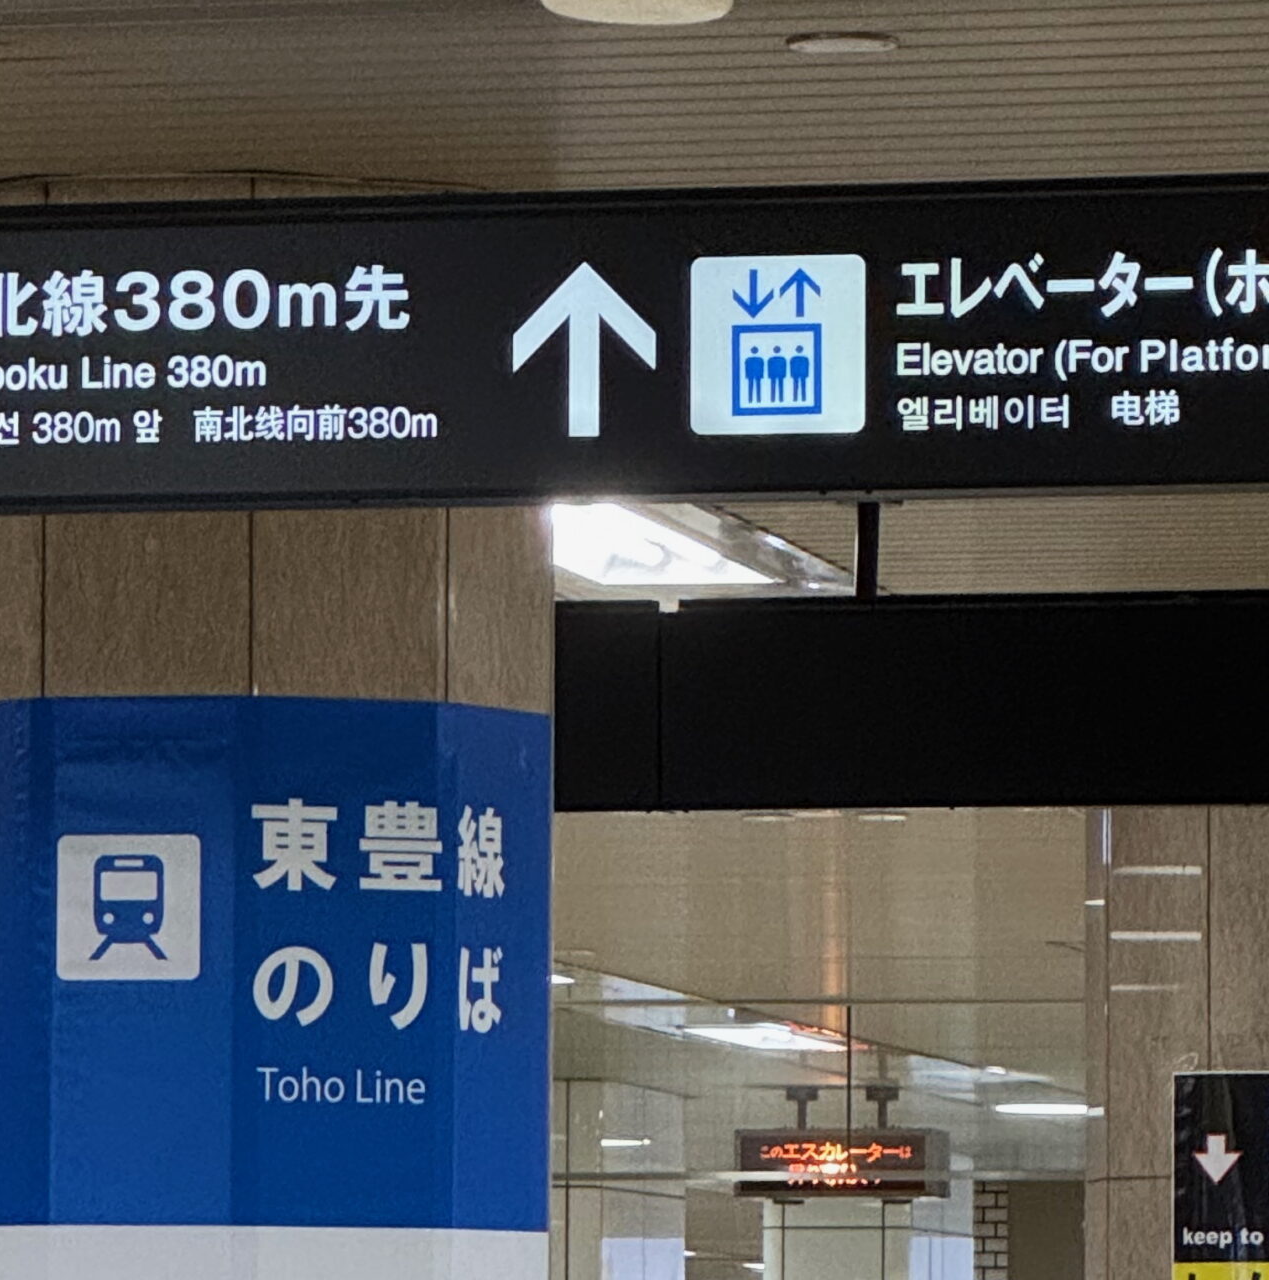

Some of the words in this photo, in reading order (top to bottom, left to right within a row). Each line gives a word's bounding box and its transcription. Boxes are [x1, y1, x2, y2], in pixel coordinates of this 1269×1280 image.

[81, 355, 157, 389] Line
[166, 354, 267, 389] 380m
[896, 342, 1044, 376] Elevator
[1054, 339, 1130, 381] (For
[31, 410, 121, 444] 380m
[132, 408, 163, 444] 앞
[192, 403, 438, 443] 南北线向前380m
[896, 393, 1070, 431] 엘리베이터
[1111, 389, 1181, 426] 电梯
[251, 798, 505, 898] 東豊線
[253, 943, 503, 1034] のりば
[257, 1067, 345, 1103] Toho
[356, 1069, 426, 1104] Line
[1183, 1227, 1233, 1249] keep
[1240, 1227, 1264, 1246] to
